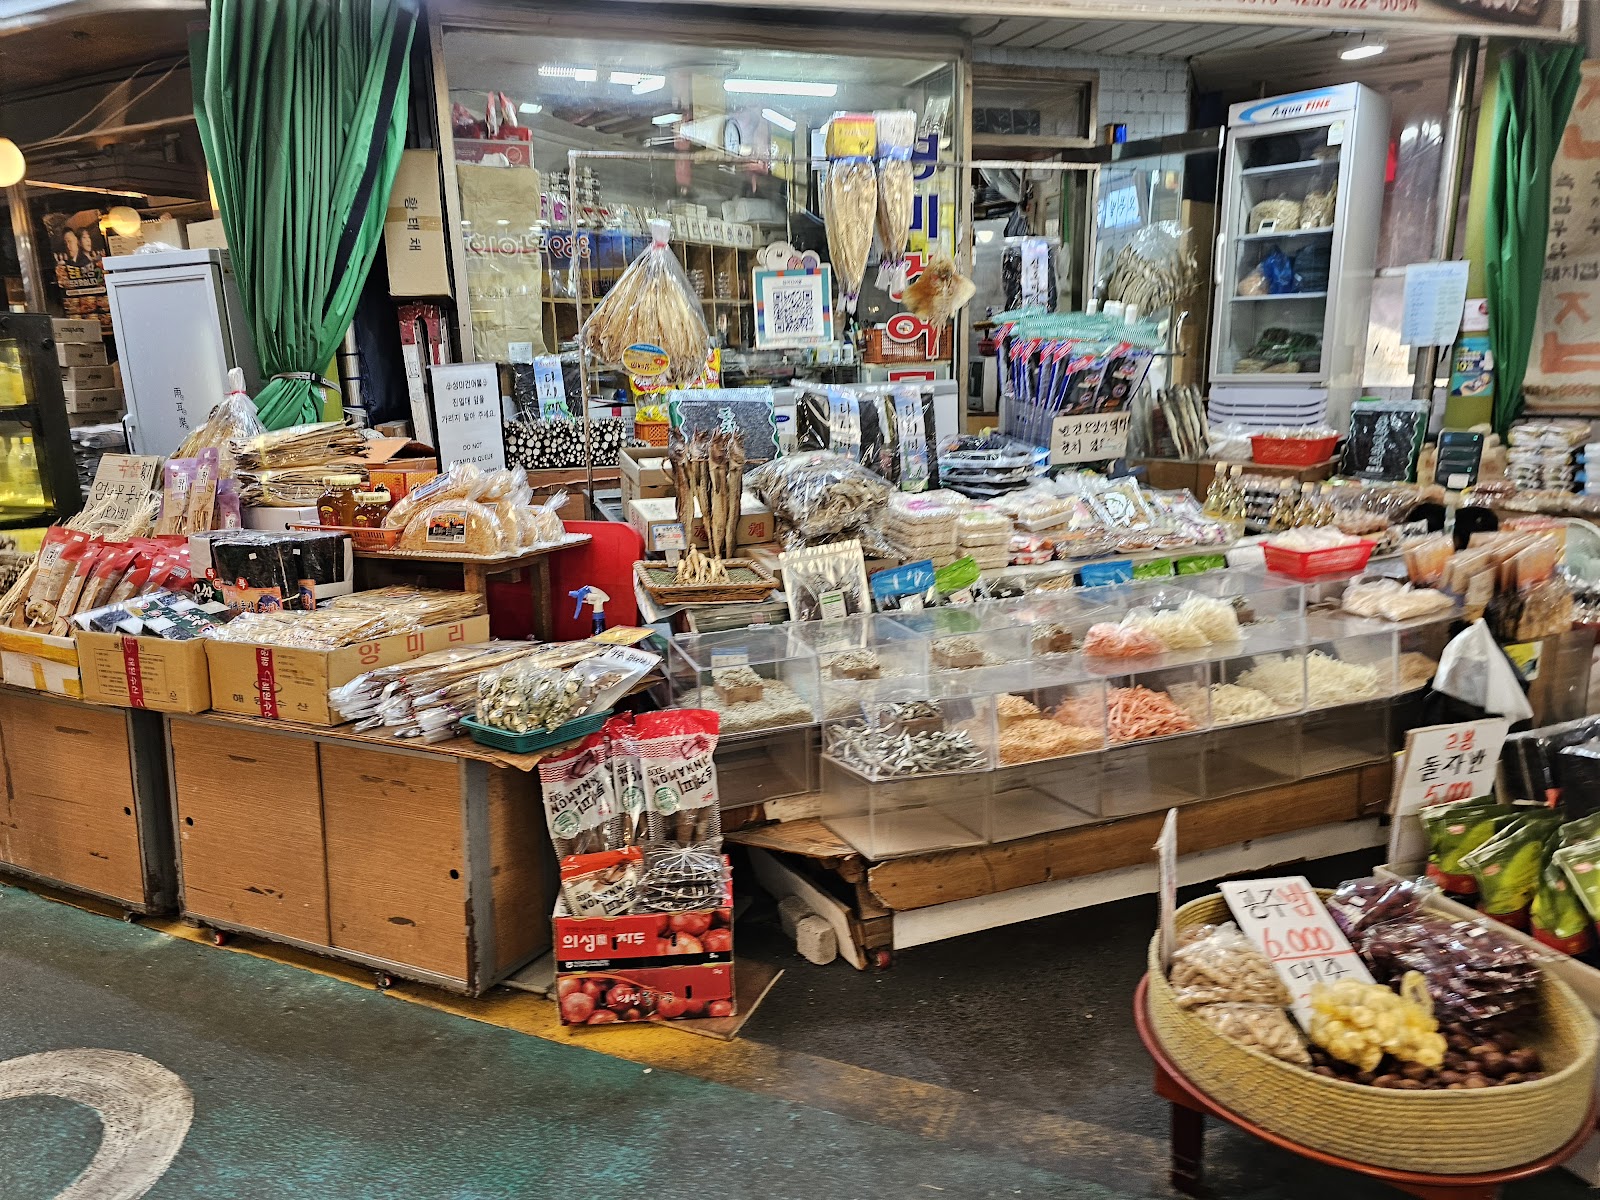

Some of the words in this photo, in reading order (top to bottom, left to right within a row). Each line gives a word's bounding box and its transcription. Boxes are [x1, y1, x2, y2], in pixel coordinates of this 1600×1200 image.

[1271, 105, 1303, 118] Aqua
[1304, 98, 1332, 112] FINE
[441, 413, 461, 424] 가리지
[472, 442, 483, 450] NOT
[359, 623, 465, 665] 양미리
[562, 932, 596, 952] 의성
